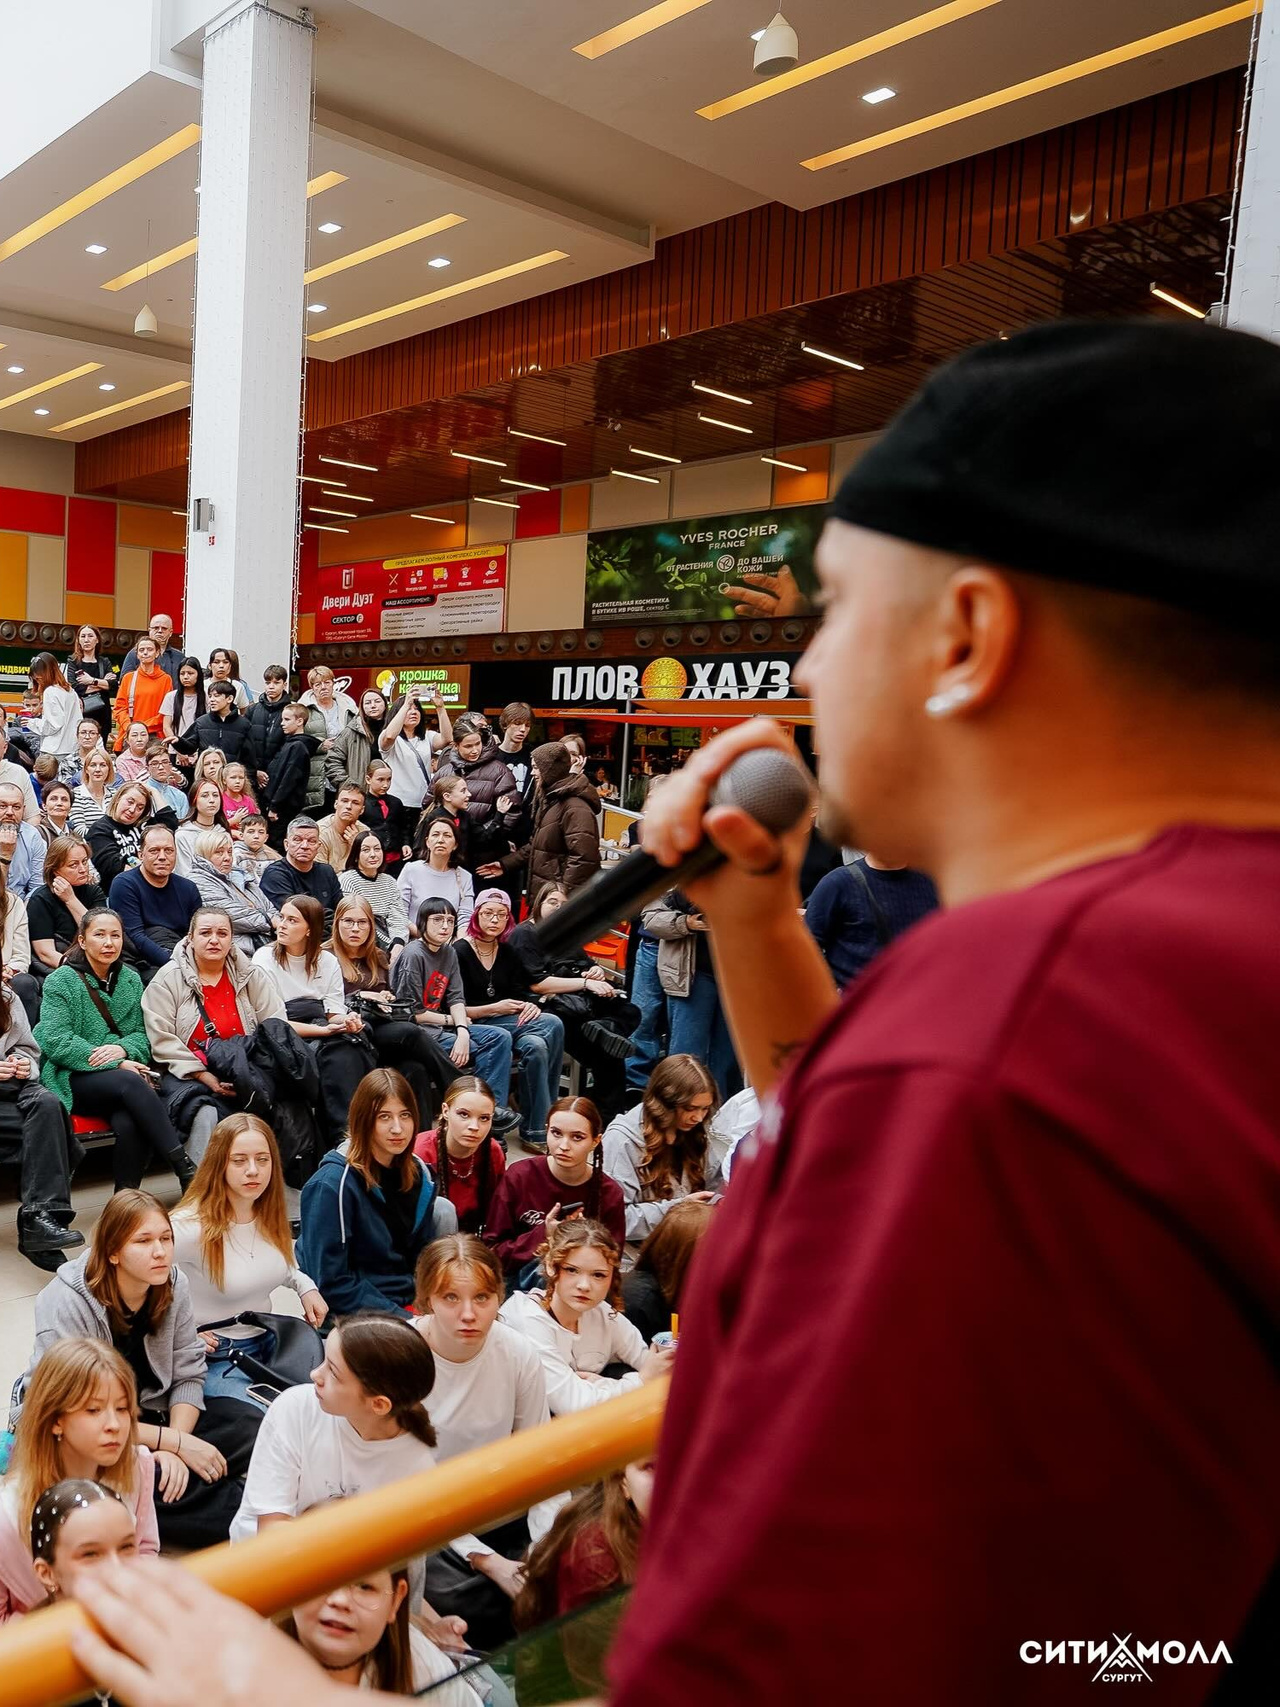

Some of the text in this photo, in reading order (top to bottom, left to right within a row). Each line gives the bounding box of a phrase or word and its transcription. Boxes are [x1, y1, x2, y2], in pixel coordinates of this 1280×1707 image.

[680, 524, 779, 545] YVES ROCHER
[708, 540, 746, 551] FRANCE
[736, 553, 784, 567] ДО ВАШЕЙ
[676, 561, 714, 572] РАСТЕНИЯ
[736, 564, 763, 574] КОЖИ
[321, 592, 374, 611] Двери Дуэт
[635, 597, 670, 605] КОСМЕТИКА
[331, 616, 356, 624] СЕКТОР
[399, 669, 448, 683] крошка
[552, 660, 791, 700] ПЛОВ ХАУЗ
[399, 682, 460, 694] кшка
